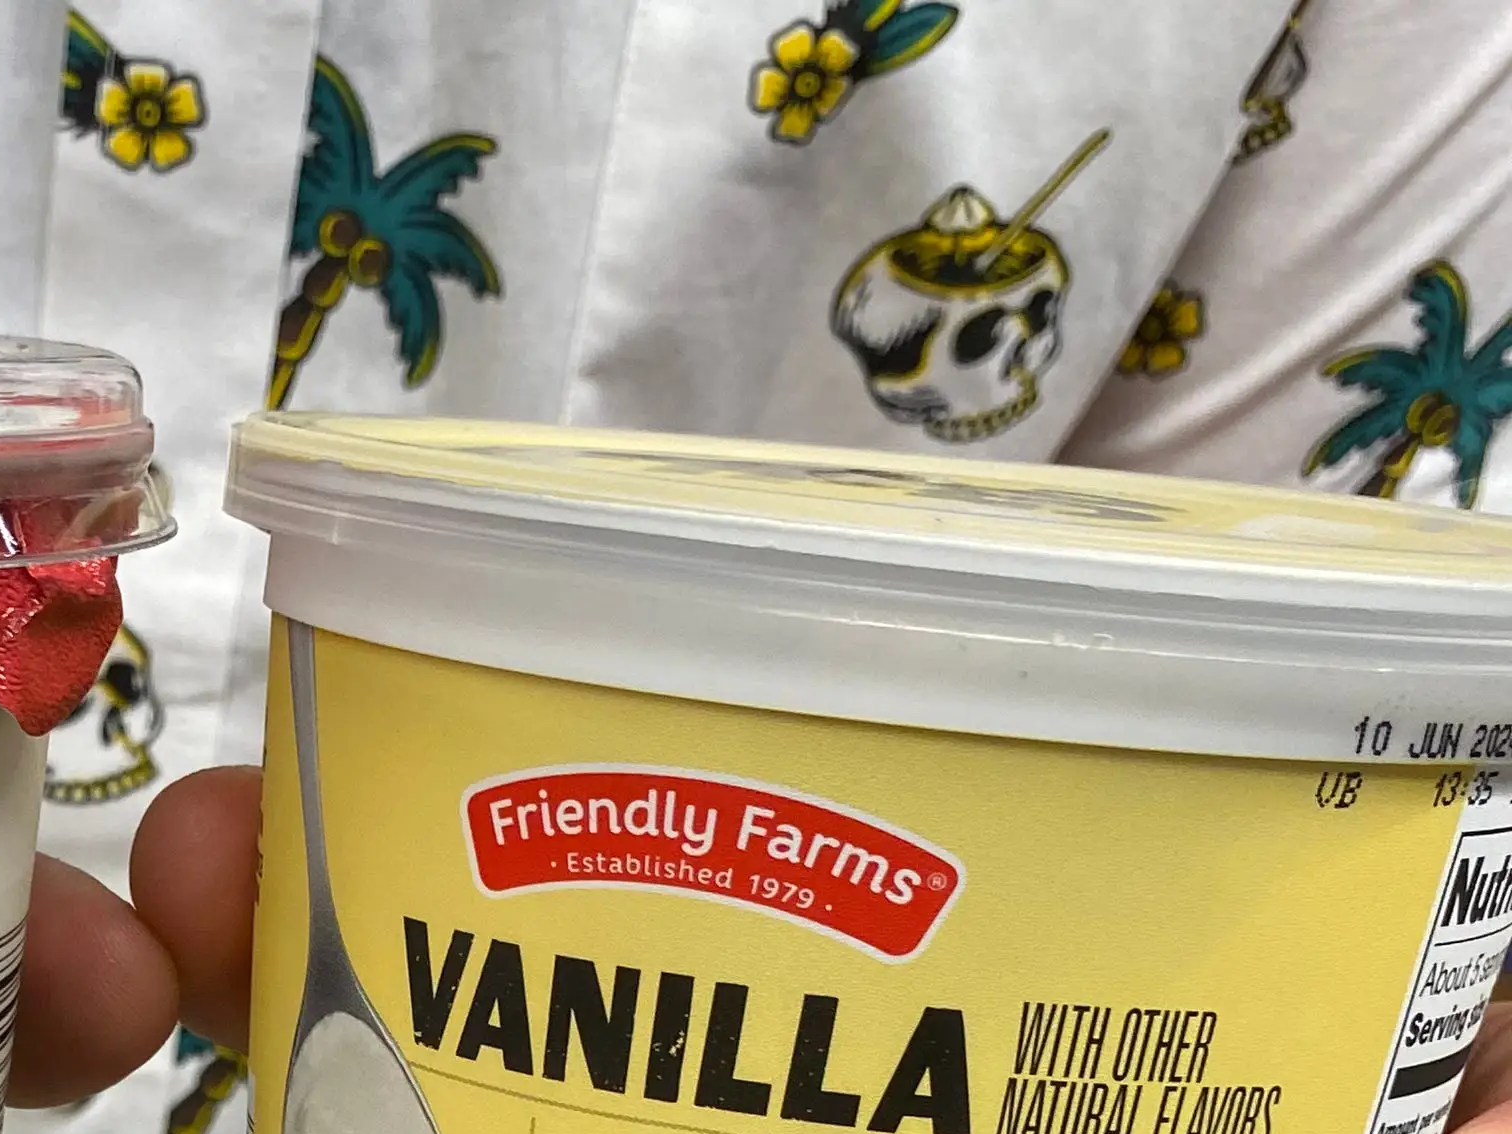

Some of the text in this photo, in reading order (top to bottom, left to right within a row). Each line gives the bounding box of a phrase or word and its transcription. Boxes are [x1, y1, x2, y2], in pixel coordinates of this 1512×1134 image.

[1354, 716, 1512, 759] 10 JUN 202
[489, 788, 718, 857] Friendly
[567, 852, 814, 909] Established 1979
[1419, 957, 1473, 998] About
[1470, 953, 1485, 986] 5
[1014, 1001, 1217, 1083] WITH OTHER
[1405, 1005, 1469, 1047] Serving
